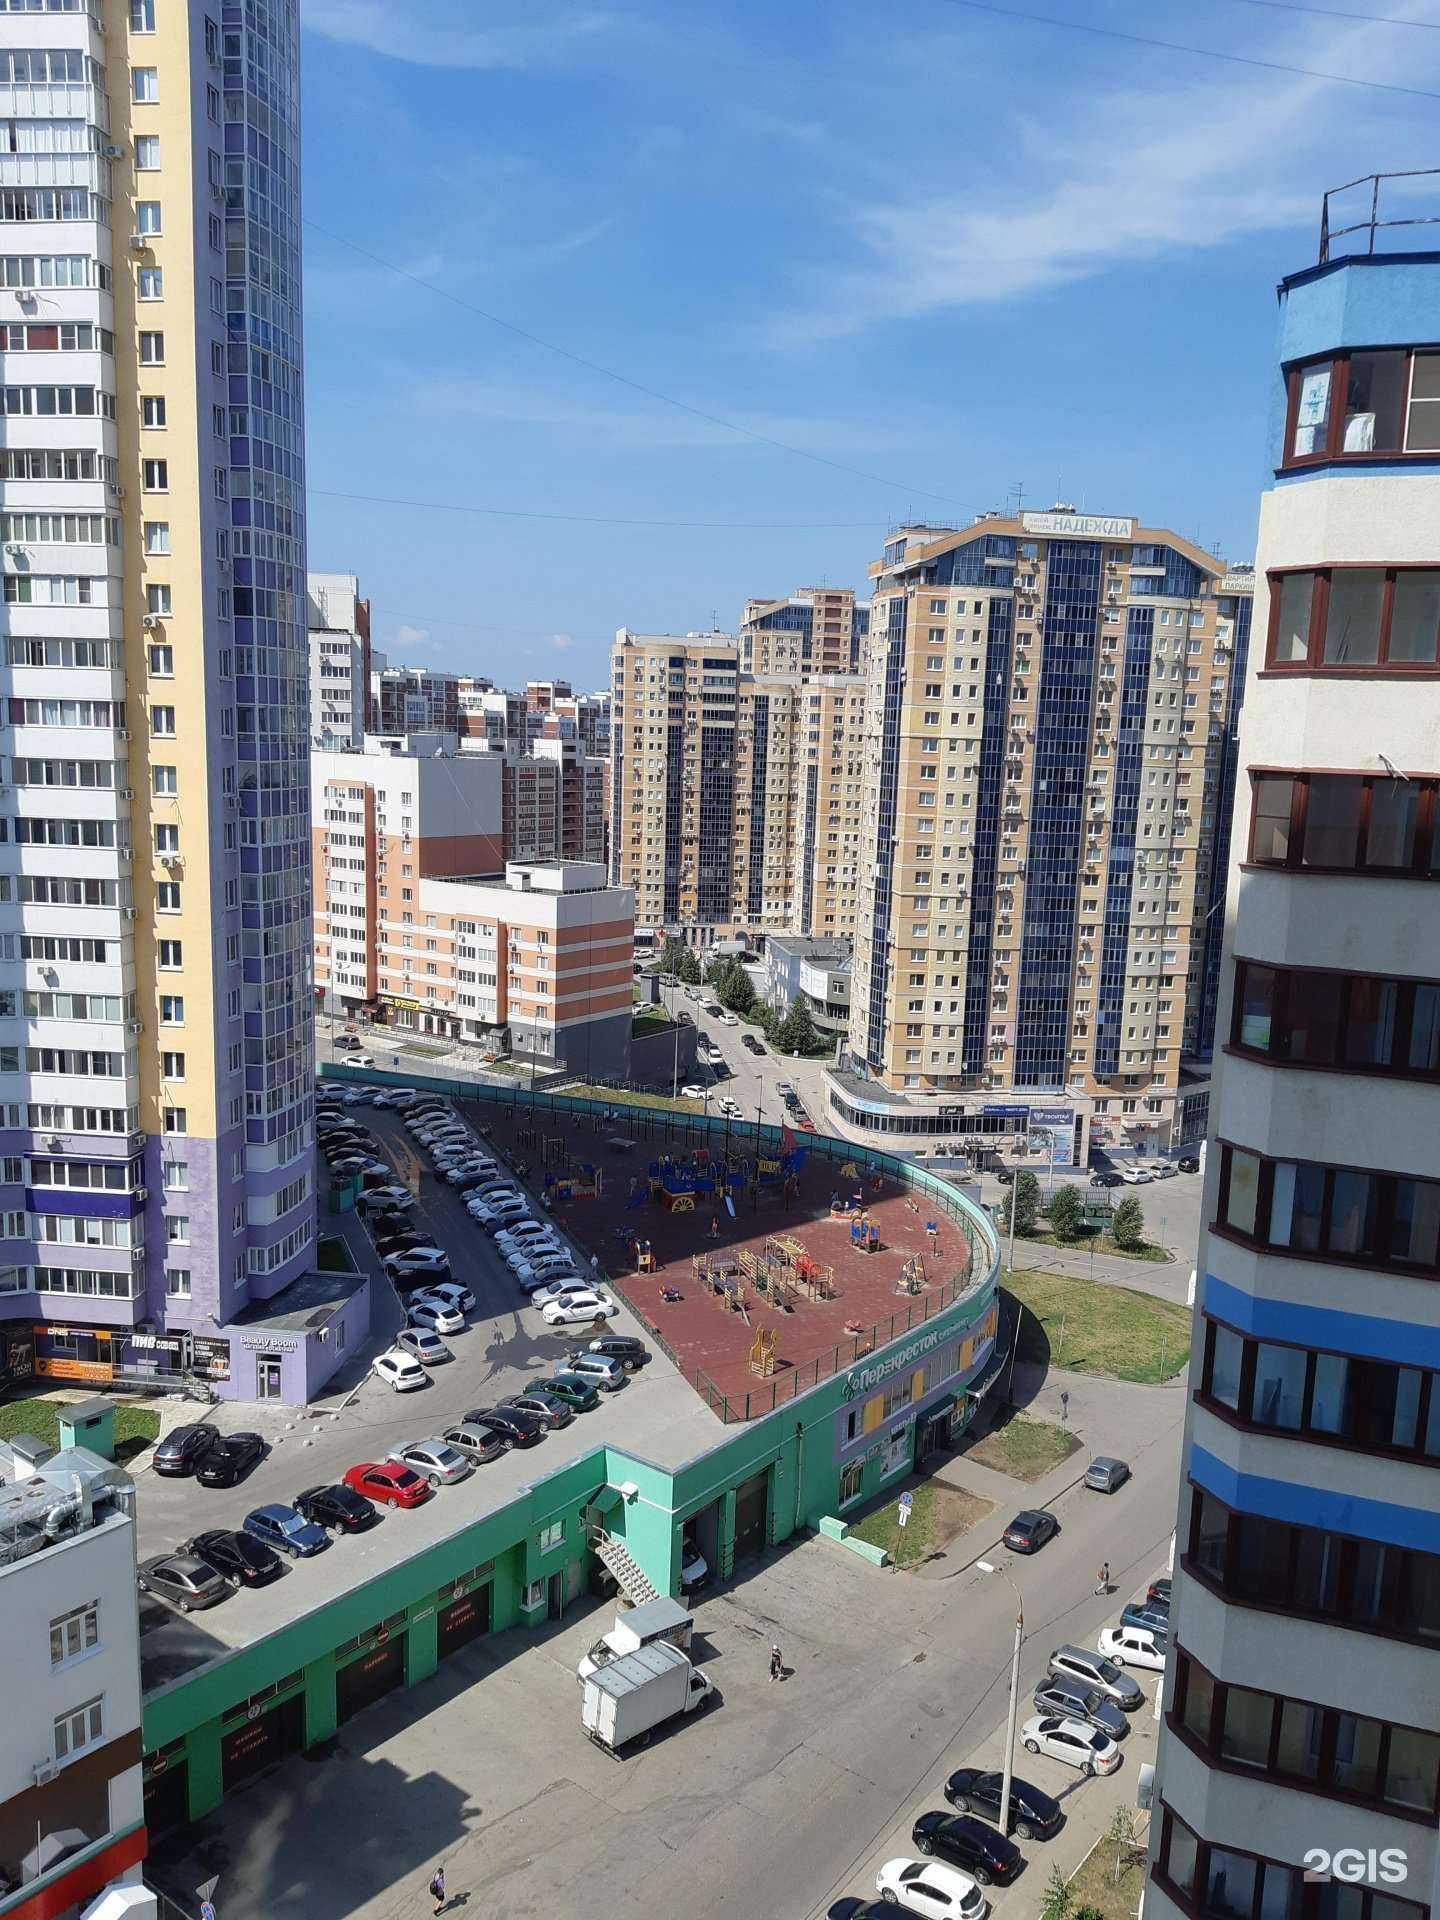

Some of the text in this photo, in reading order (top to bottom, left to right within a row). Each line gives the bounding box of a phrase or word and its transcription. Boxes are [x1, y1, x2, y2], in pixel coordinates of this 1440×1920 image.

[1053, 516, 1130, 537] НАДЕЖДА
[47, 1327, 69, 1336] DNS
[240, 1335, 269, 1347] Beauty
[271, 1337, 298, 1349] Boom
